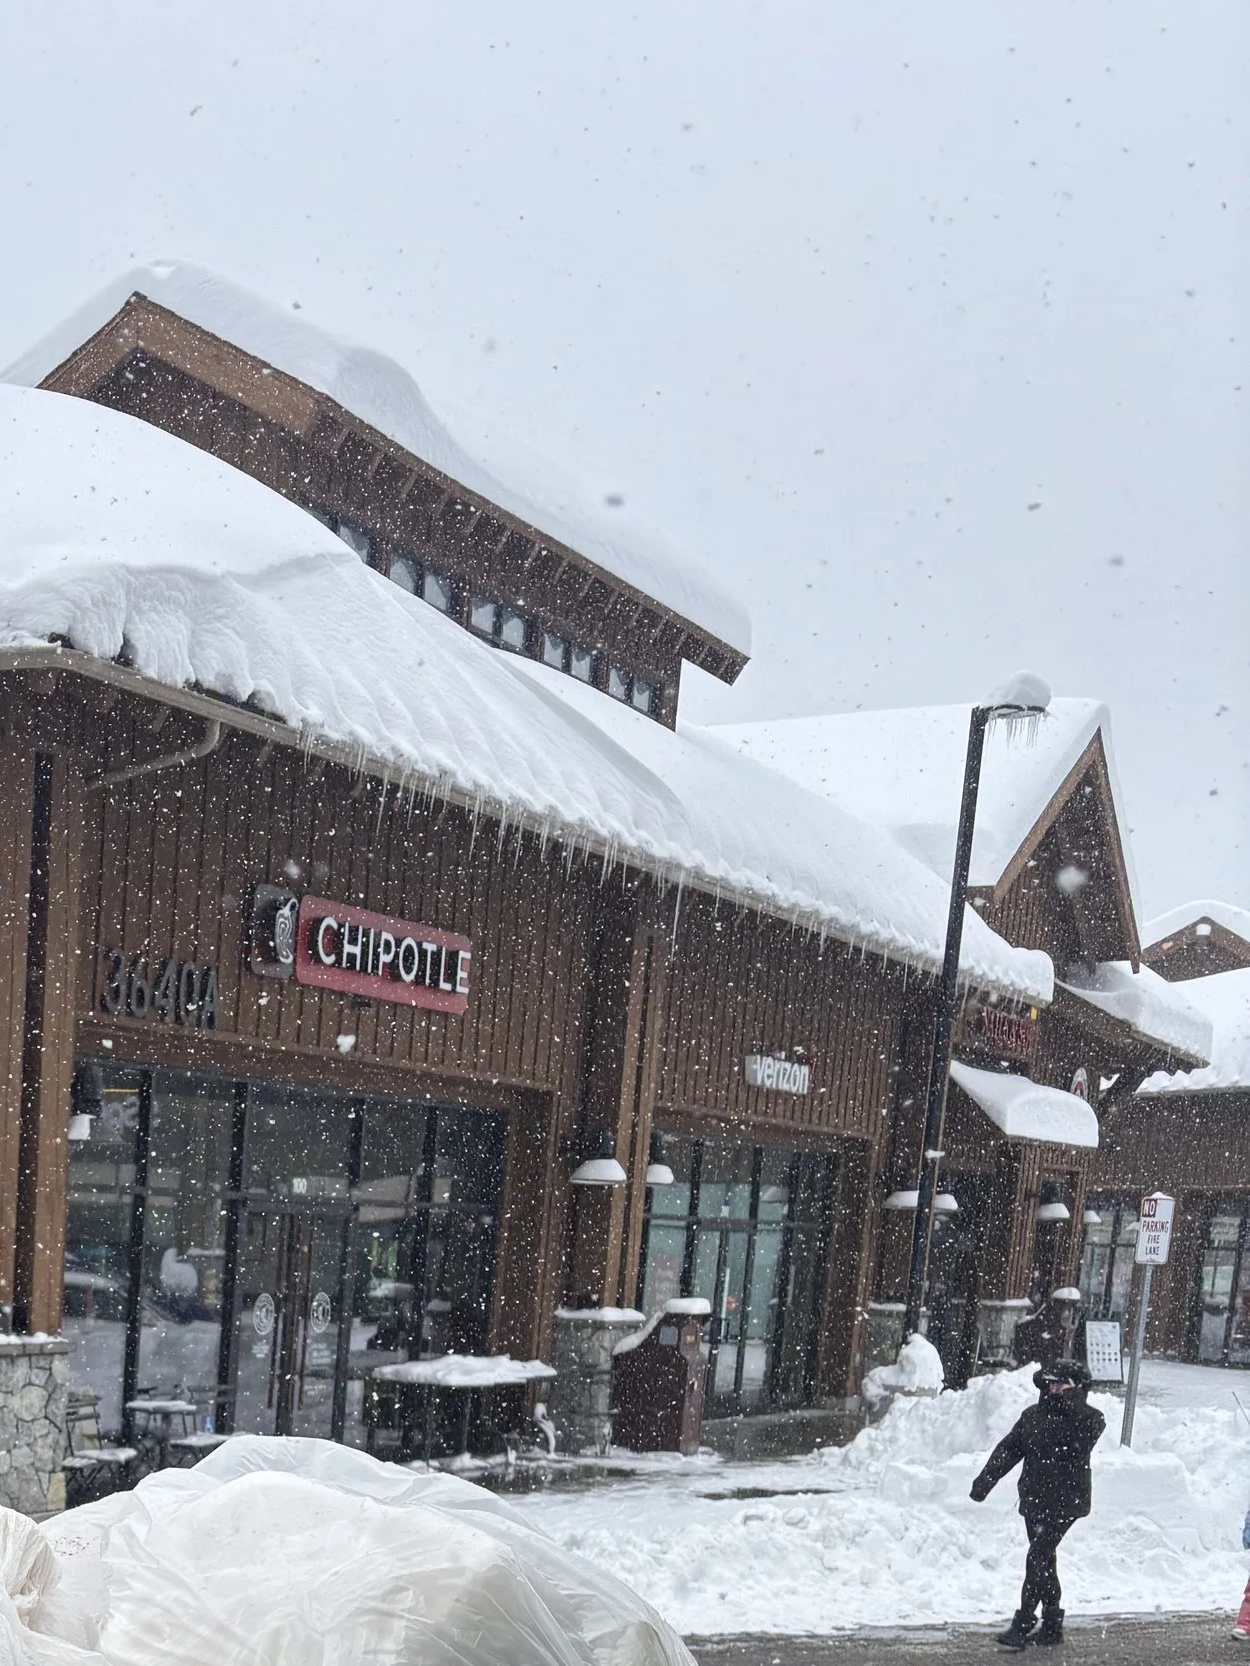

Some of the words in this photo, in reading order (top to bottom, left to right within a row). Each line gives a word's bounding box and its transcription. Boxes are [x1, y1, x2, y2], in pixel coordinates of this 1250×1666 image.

[318, 916, 472, 995] CHIPOTLE
[756, 1054, 809, 1095] verizon
[1143, 1200, 1156, 1216] NO
[1142, 1220, 1170, 1234] PARKING
[1147, 1234, 1160, 1245] FIRE
[1145, 1246, 1160, 1256] LANE
